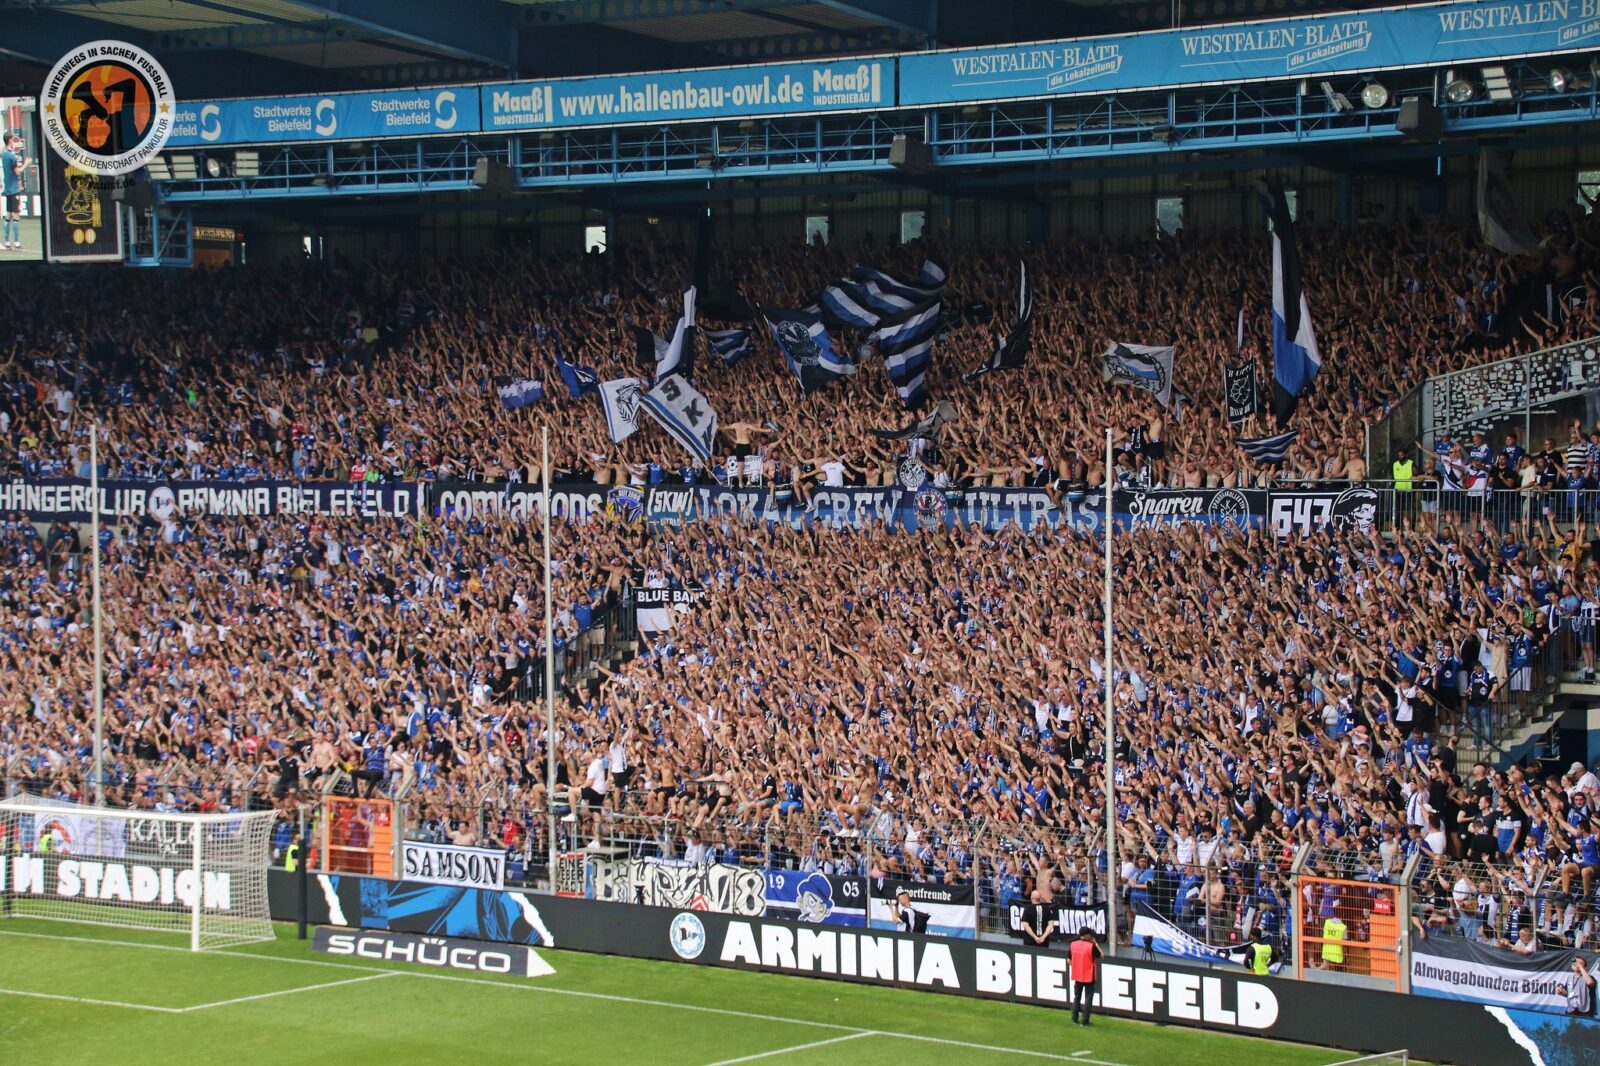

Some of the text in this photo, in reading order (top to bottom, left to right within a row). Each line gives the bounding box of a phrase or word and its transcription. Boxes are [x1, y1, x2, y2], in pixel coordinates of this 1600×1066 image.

[1181, 21, 1368, 56] WESTFALEN-BLATT
[1563, 29, 1579, 40] die
[952, 45, 1119, 76] WESTFALEN-BLATT
[1291, 38, 1363, 66] die Lokalzeitung
[813, 65, 869, 92] Maaß
[1050, 60, 1115, 86] die Lokalzeitung
[371, 98, 430, 113] Stadtwerke
[493, 87, 543, 113] Maaß
[560, 76, 804, 117] www.hallenbau-owl.de
[813, 92, 870, 106] INDUSTRIEBAU
[254, 106, 311, 118] Stadtwerke
[268, 119, 312, 132] Bielefeld
[386, 112, 430, 126] Bielefeld
[494, 113, 544, 126] INDUSTRIEBAU
[178, 487, 270, 516] ARMINIA
[813, 489, 903, 531] CREW
[1129, 492, 1204, 520] Sparren
[1271, 498, 1333, 537] 647
[637, 590, 669, 602] BLUE
[406, 848, 500, 885] SAMSON
[57, 860, 231, 909] STADION
[768, 874, 860, 897] 19 05
[327, 934, 512, 973] SCHÜCO
[720, 921, 960, 988] ARMINIA
[976, 948, 1279, 1029] BIEEFELD
[1414, 961, 1519, 993] Almvagabunden
